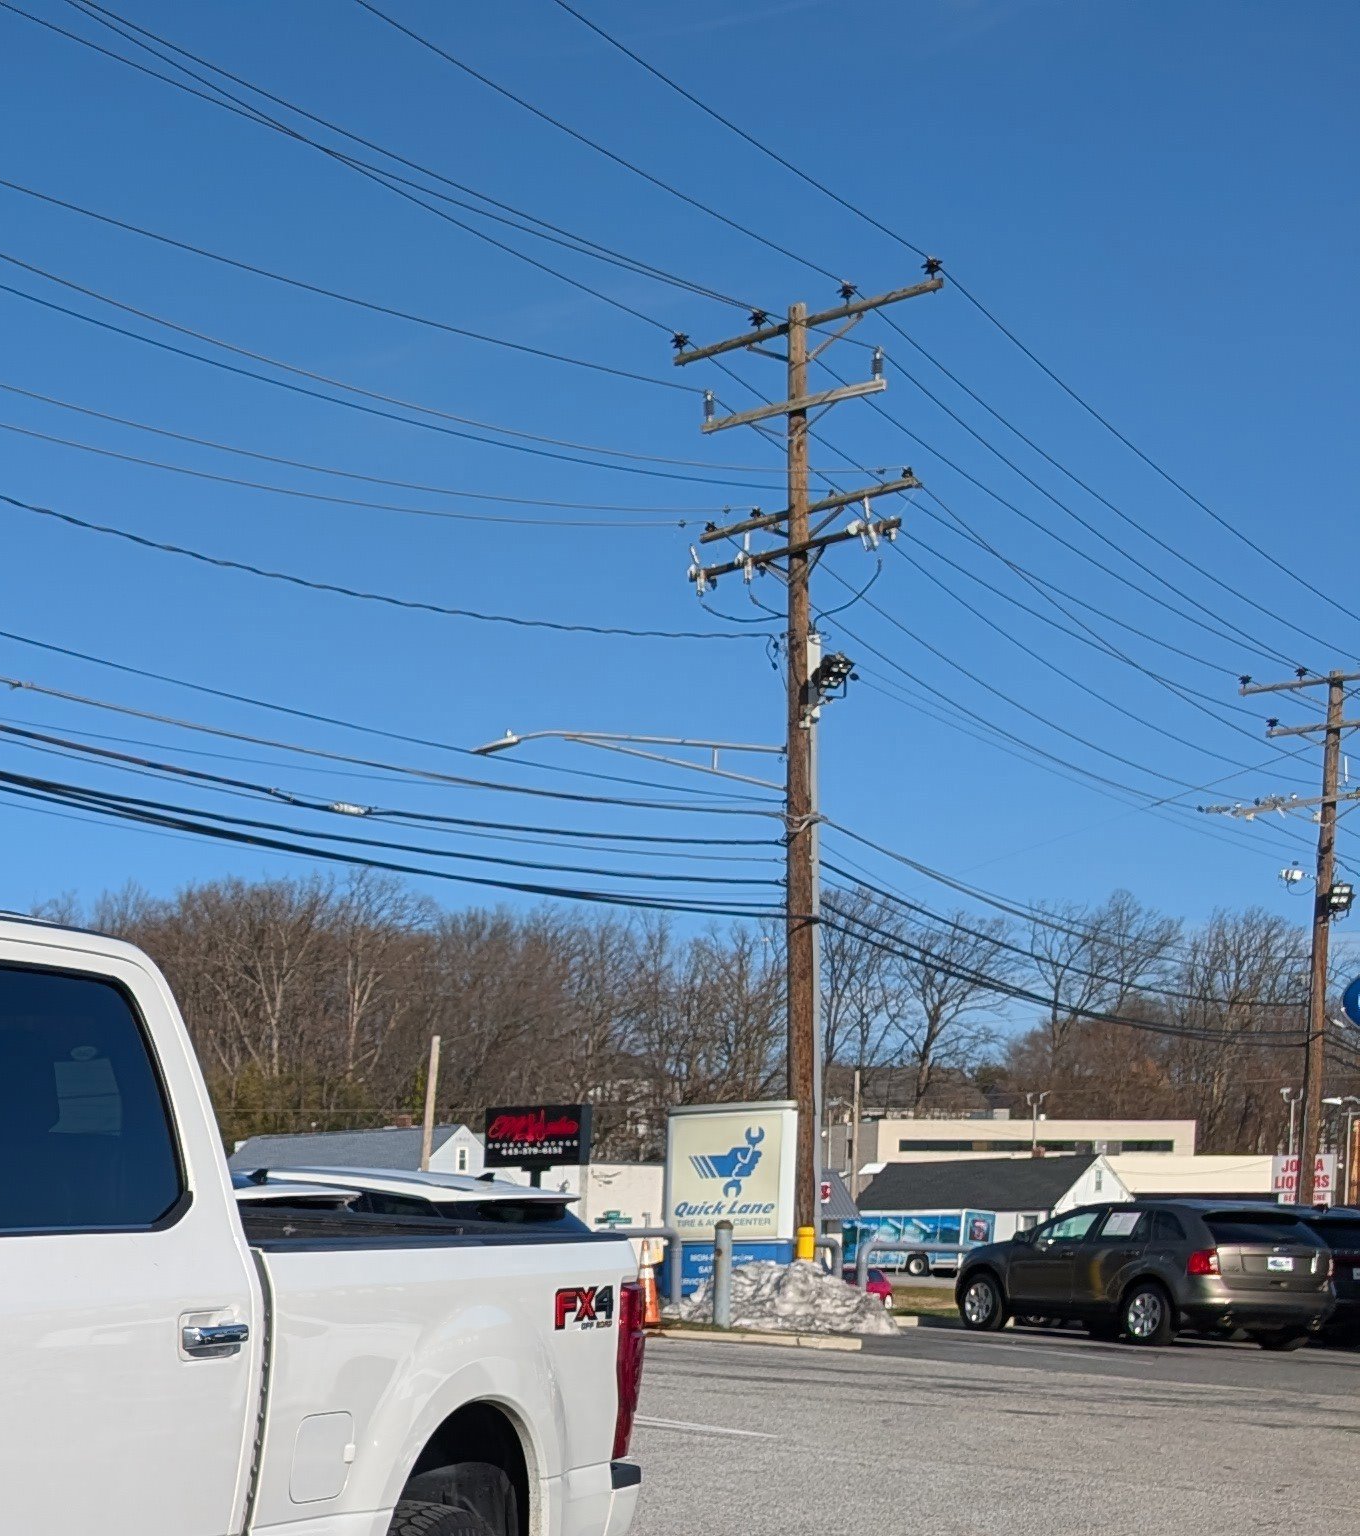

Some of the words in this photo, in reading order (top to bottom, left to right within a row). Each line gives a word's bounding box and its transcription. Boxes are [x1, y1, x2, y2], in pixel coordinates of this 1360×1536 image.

[1281, 1159, 1324, 1172] JOA
[1275, 1175, 1330, 1190] LIQRS
[674, 1201, 726, 1217] Quick
[727, 1200, 775, 1214] Lane
[677, 1219, 695, 1227] TIRE
[733, 1218, 771, 1226] CENTER
[555, 1285, 614, 1330] FX4
